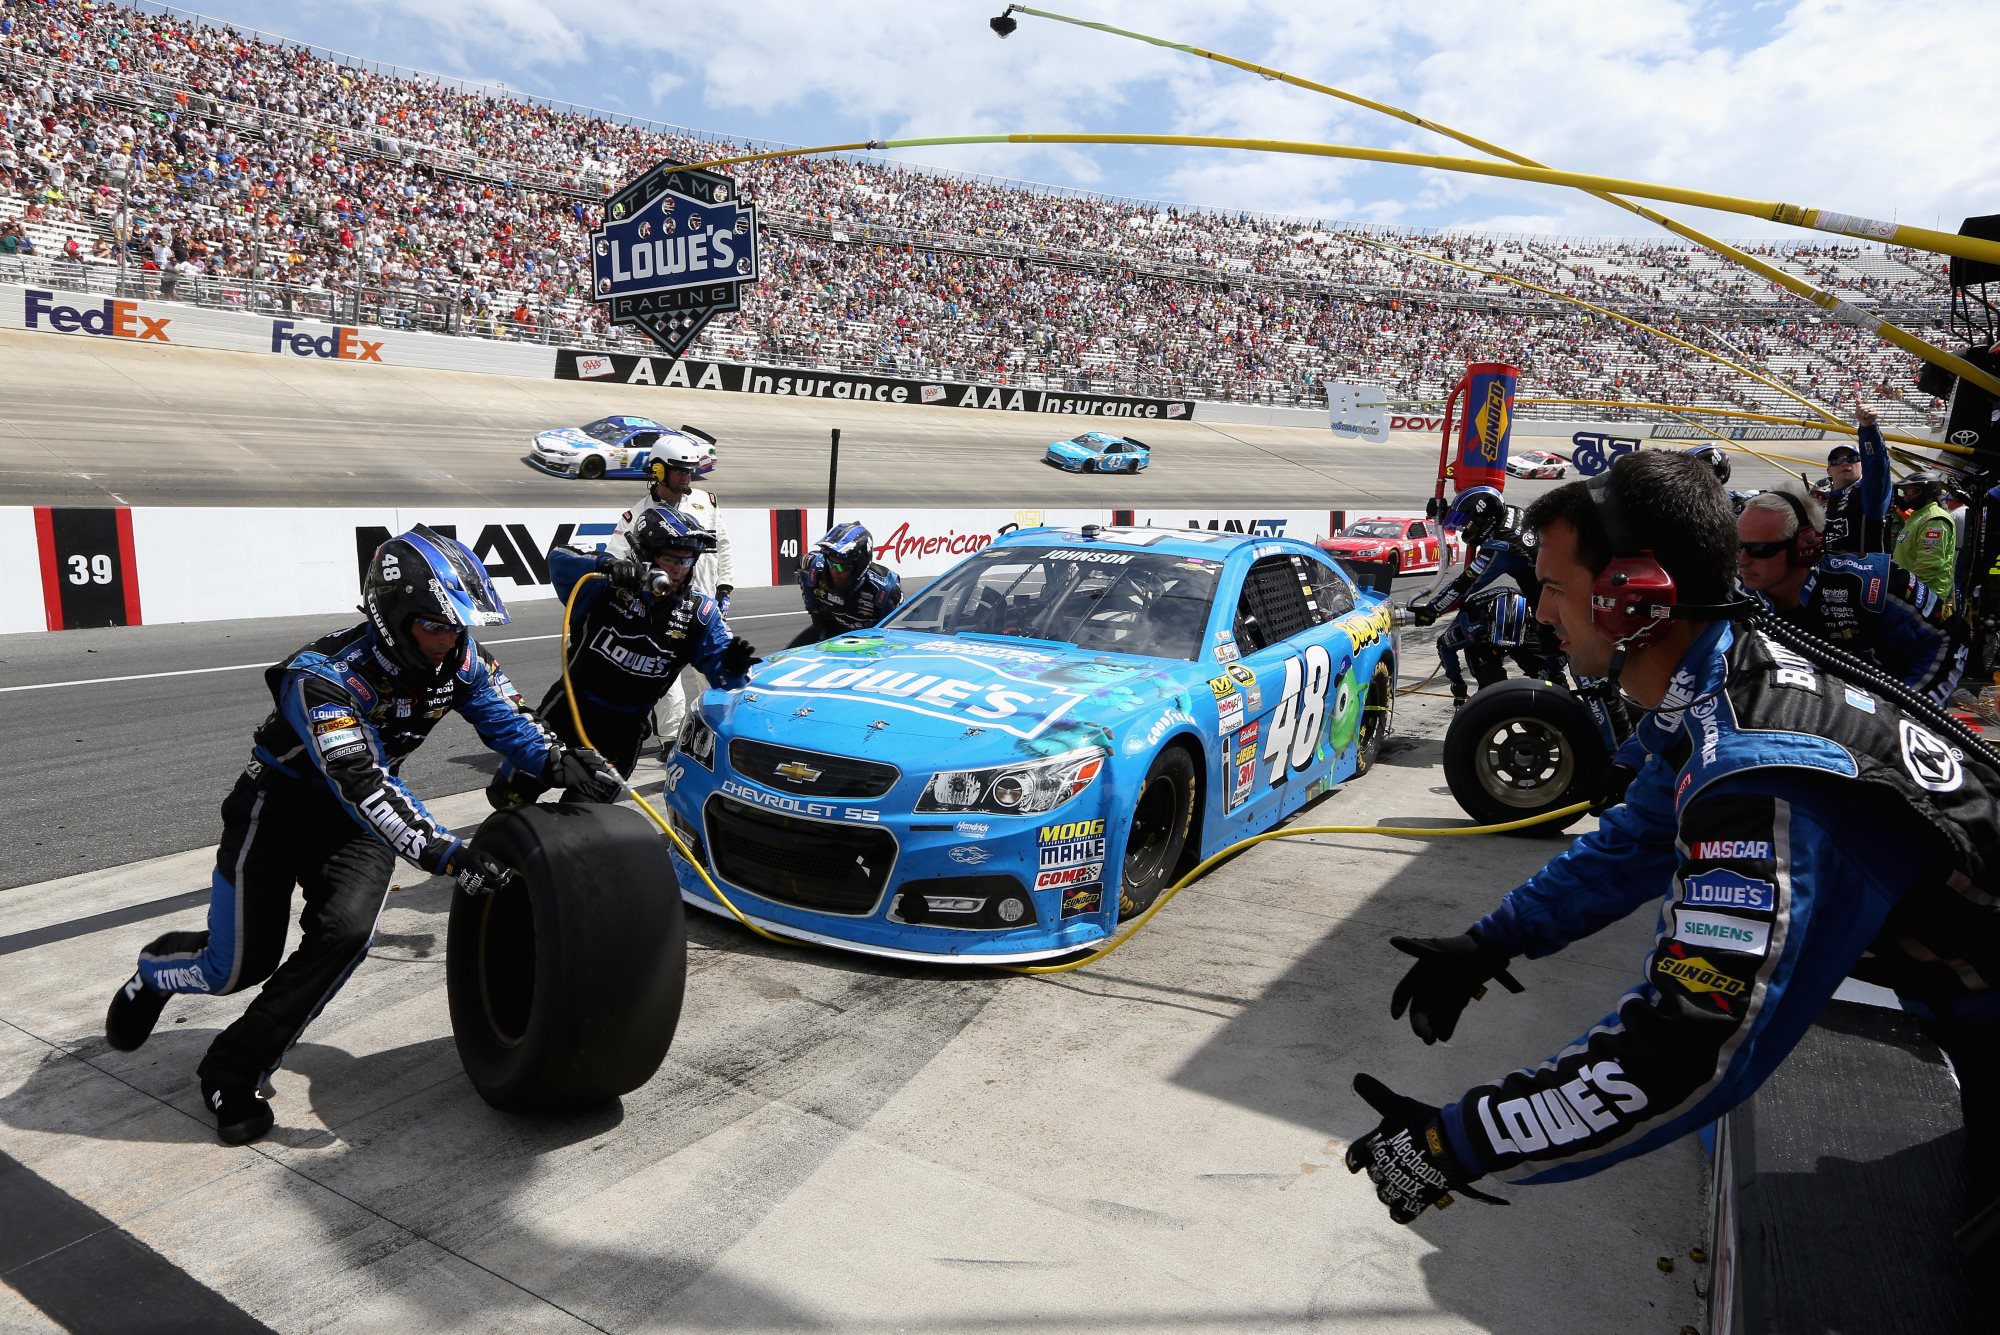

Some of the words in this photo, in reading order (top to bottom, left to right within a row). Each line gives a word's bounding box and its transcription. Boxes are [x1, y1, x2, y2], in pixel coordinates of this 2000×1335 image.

[626, 174, 709, 213] TEAM
[611, 224, 734, 283] LOWE'S
[620, 287, 726, 313] RACING
[24, 290, 171, 342] FedEx
[272, 320, 385, 362] FedEx
[582, 359, 602, 371] AAA
[627, 357, 724, 390] AAA
[741, 366, 908, 403] Insurance
[958, 386, 1025, 411] AAA
[1037, 393, 1158, 418] Insurance
[1484, 384, 1505, 458] SUNOCO
[1108, 455, 1122, 468] 43
[1476, 500, 1487, 513] 48
[780, 539, 798, 558] 40
[873, 521, 992, 564] American
[1039, 549, 1135, 565] JOHNSON
[1418, 541, 1428, 563] 1
[68, 553, 113, 586] 39
[381, 553, 401, 582] 48
[601, 633, 668, 674] LOWE'S
[768, 662, 1036, 719] LOWE'S
[1655, 669, 1697, 733] LOWE'S
[313, 709, 348, 720] LOWE'S
[328, 716, 356, 730] BOSCH
[1147, 709, 1197, 745] GOODYEAR
[1264, 645, 1331, 784] 48
[323, 731, 357, 745] SIEMENS
[666, 763, 685, 792] 48
[1238, 761, 1255, 787] 3M
[721, 780, 838, 817] CHEVROLET
[844, 807, 880, 822] SS
[360, 788, 426, 860] LOWE'S
[956, 820, 990, 833] Hendrick
[1039, 818, 1105, 843] MOOG
[1041, 840, 1104, 865] MAHLE
[1699, 841, 1768, 859] NASCAR
[1038, 867, 1087, 887] COMP
[1071, 874, 1093, 884] CAMS
[1064, 894, 1099, 909] SUNOCO
[1691, 882, 1763, 906] LOWE'S
[1684, 921, 1753, 943] SIEMENS
[1660, 959, 1742, 994] SUNOCO
[1478, 1060, 1648, 1154] LOWE'S
[1390, 1128, 1448, 1189] Mechanix
